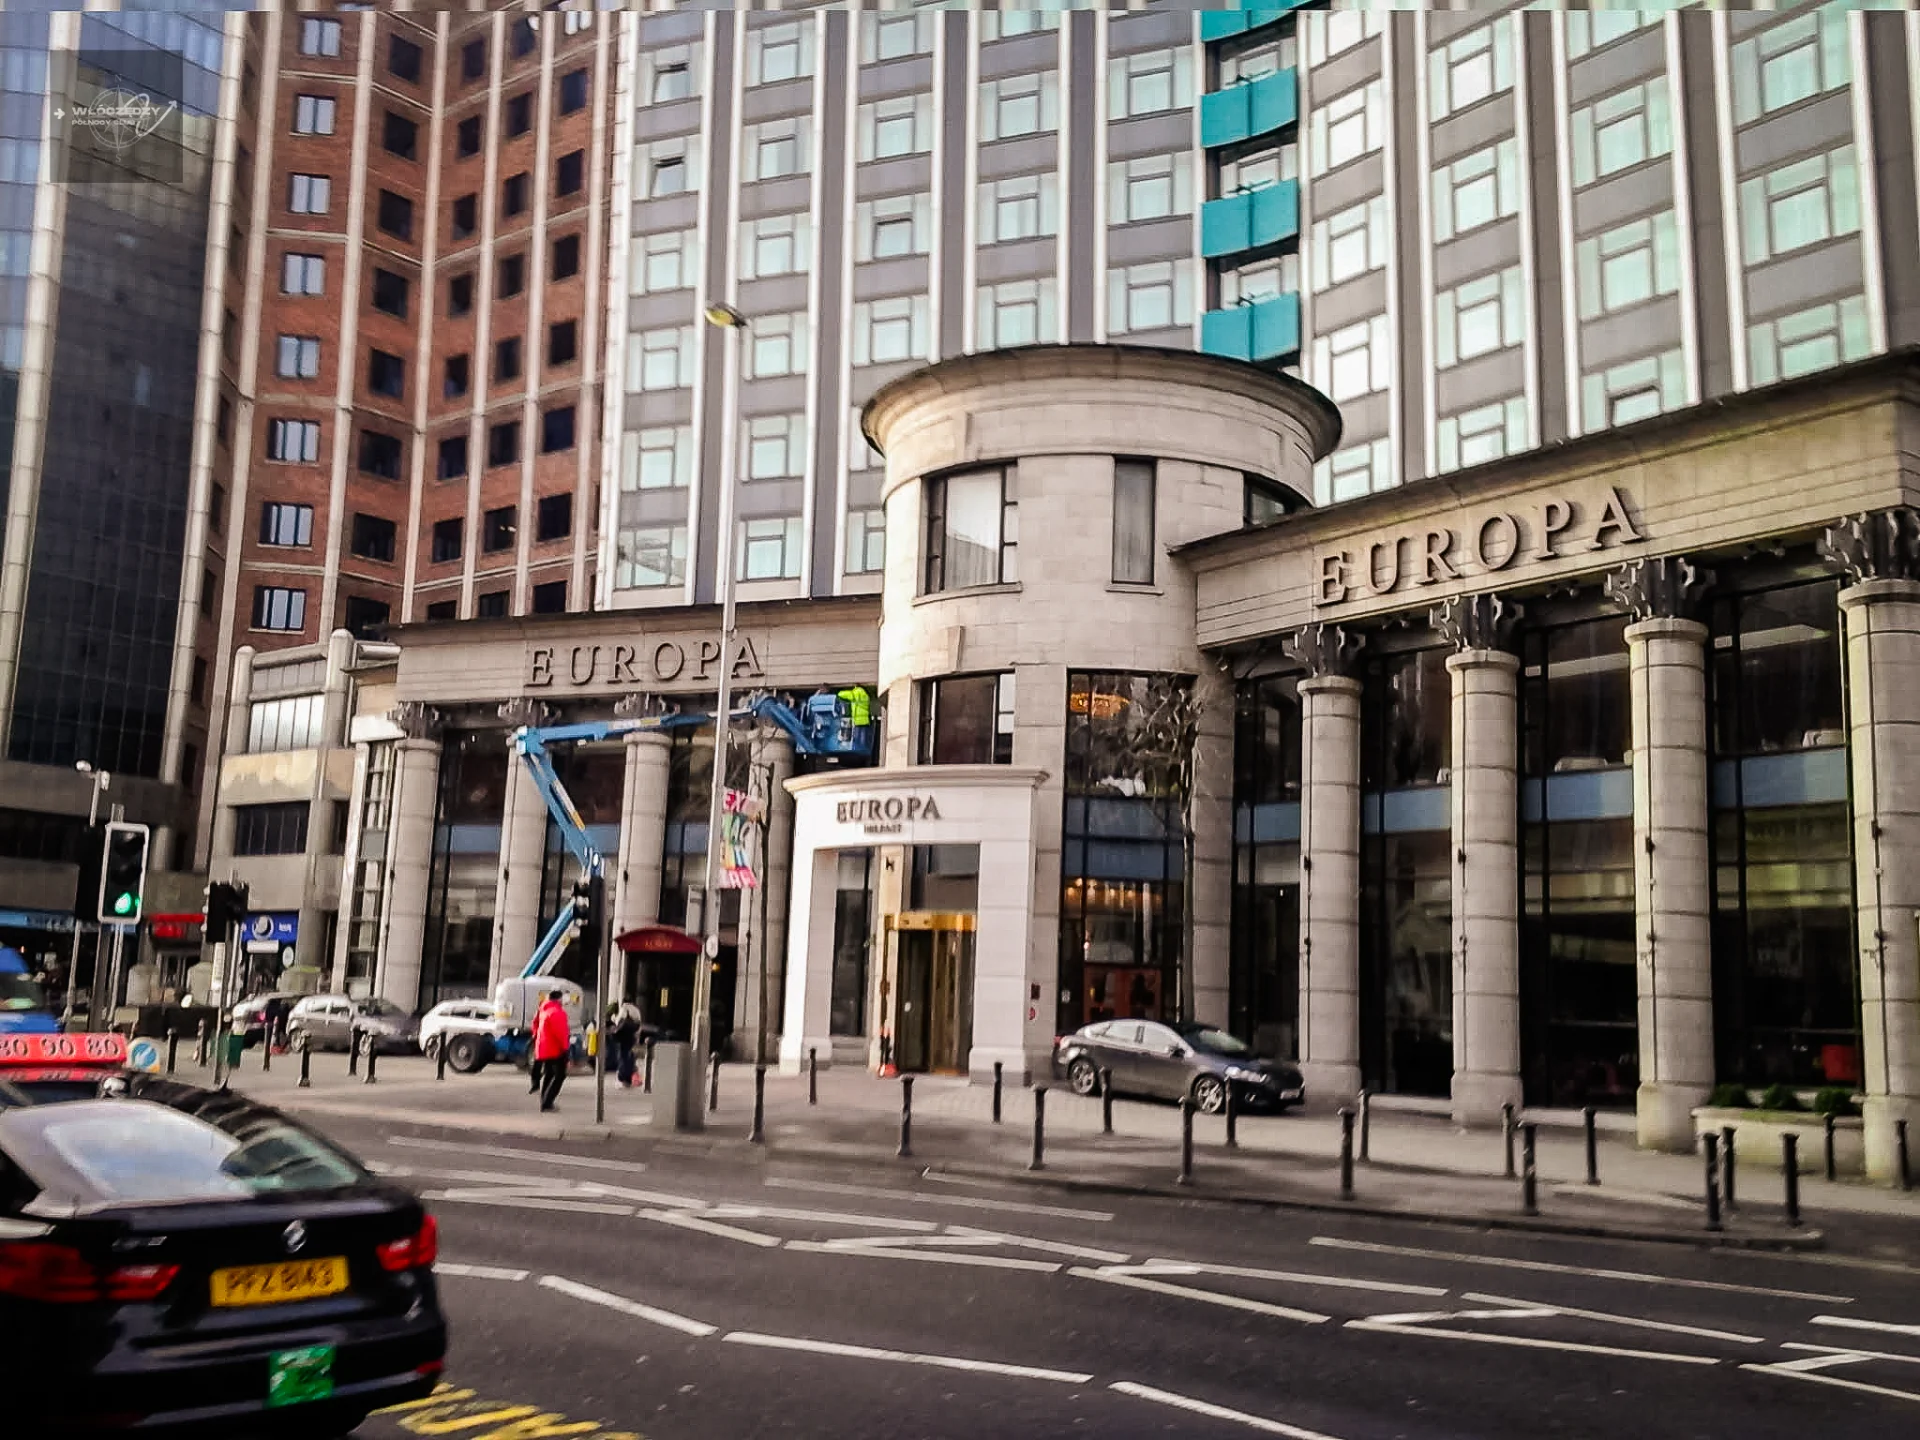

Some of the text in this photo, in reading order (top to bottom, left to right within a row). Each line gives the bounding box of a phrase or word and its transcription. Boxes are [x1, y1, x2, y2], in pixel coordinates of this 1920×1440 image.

[1316, 486, 1644, 608] EUROPA
[523, 637, 766, 687] EUROPA
[836, 794, 942, 823] EUROPA
